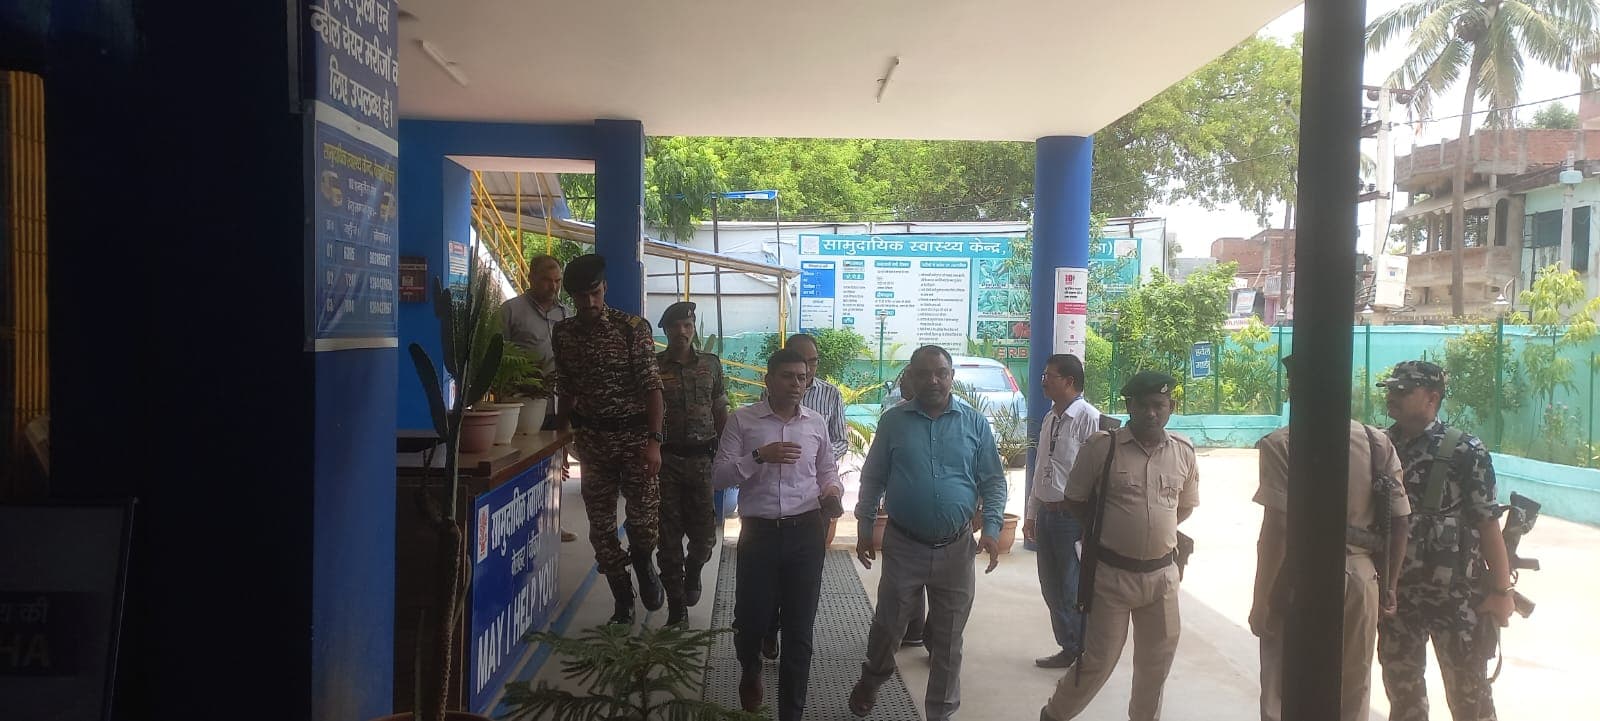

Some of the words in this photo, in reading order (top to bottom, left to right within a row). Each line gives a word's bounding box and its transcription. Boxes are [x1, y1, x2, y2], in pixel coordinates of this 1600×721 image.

[329, 54, 348, 106] लिए
[822, 236, 904, 254] सामुदायिक
[909, 241, 964, 253] स्वास्थ्य
[491, 486, 526, 556] सामुदायिक
[477, 610, 505, 695] MAY
[506, 603, 511, 655] I
[513, 576, 536, 646] HELP
